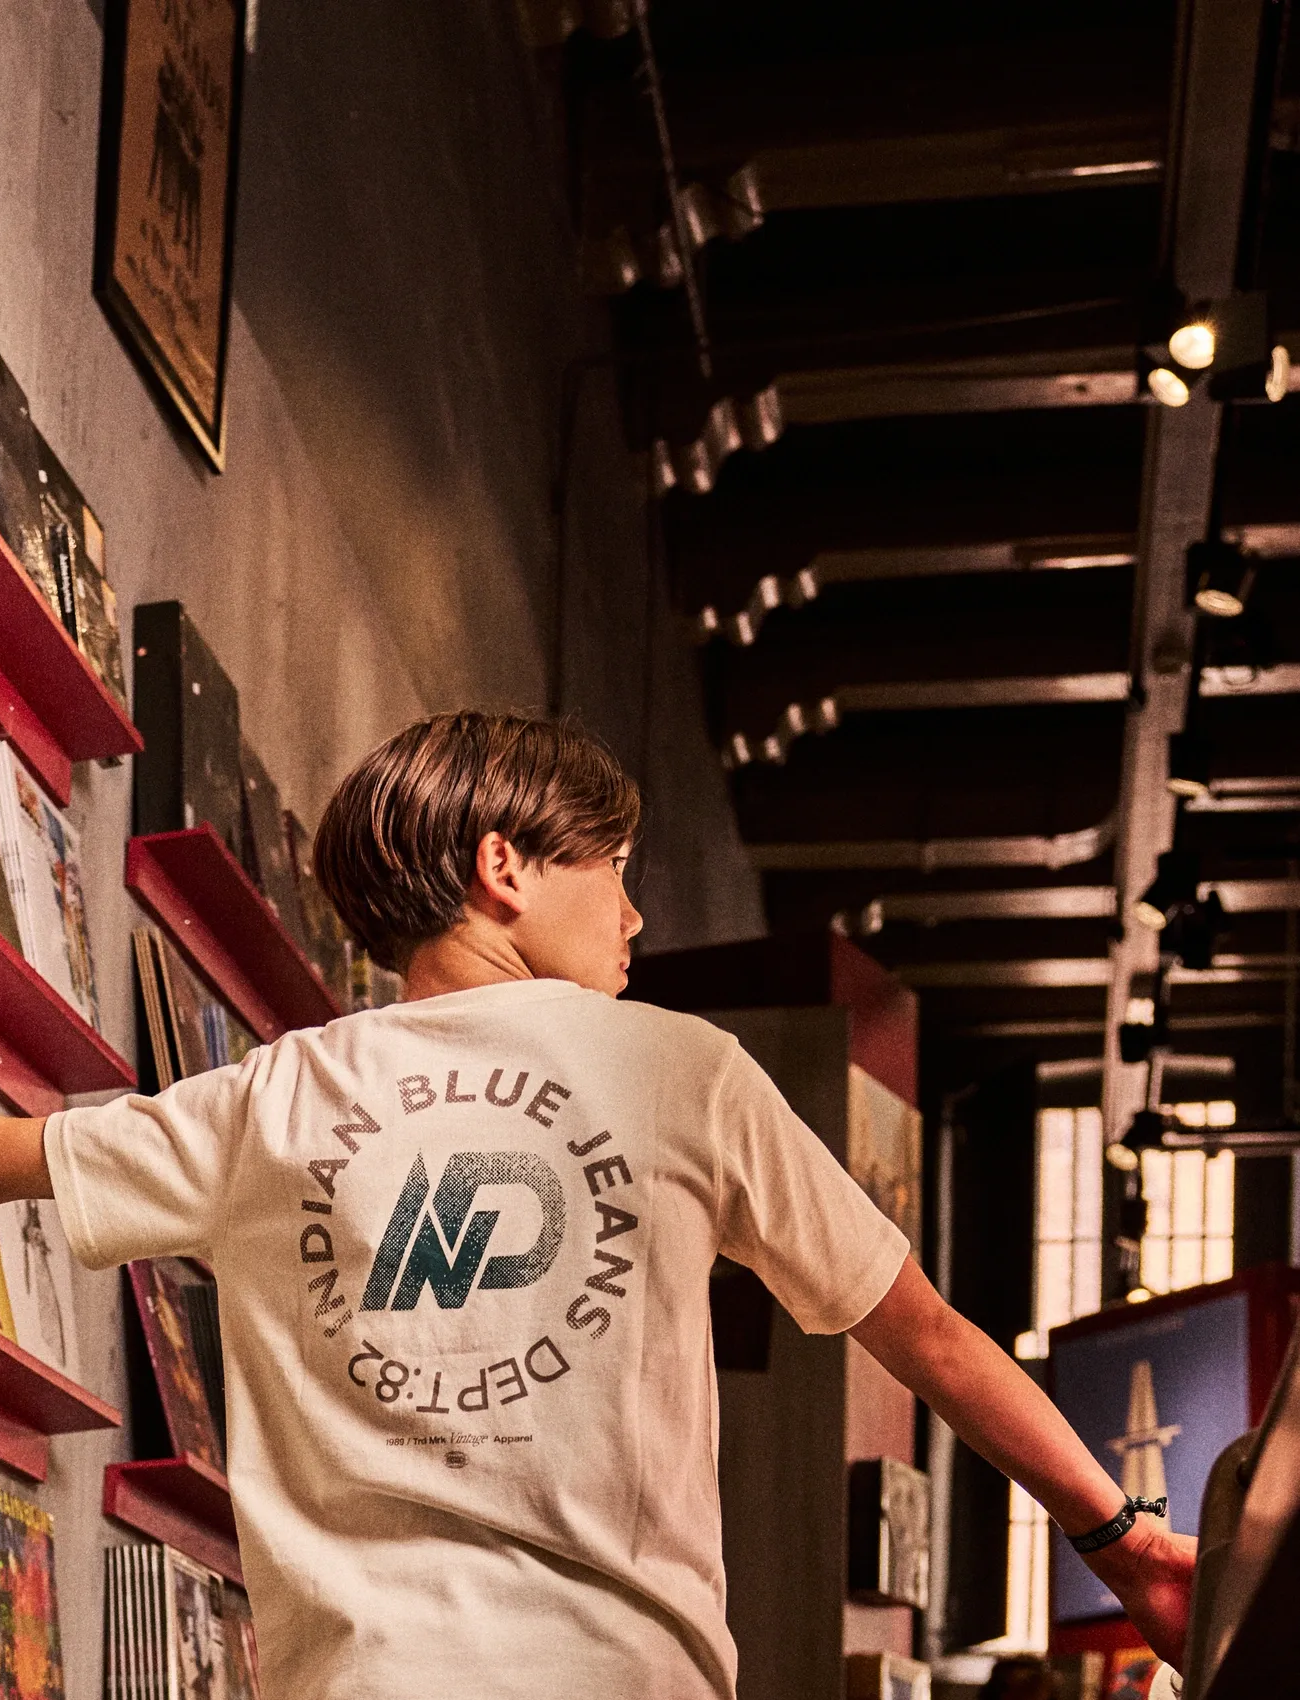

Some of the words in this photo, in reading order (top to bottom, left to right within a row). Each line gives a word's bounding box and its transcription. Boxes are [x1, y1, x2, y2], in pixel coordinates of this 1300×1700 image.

[299, 1102, 383, 1340] INDIAN
[396, 1068, 571, 1130] BLUE
[566, 1130, 639, 1340] JEANS
[385, 1438, 405, 1446] 1989
[413, 1437, 428, 1445] Trd
[428, 1436, 447, 1445] Mrk
[449, 1432, 488, 1447] Vintage
[493, 1434, 534, 1445] Apparel
[1096, 1522, 1123, 1544] GUTS
